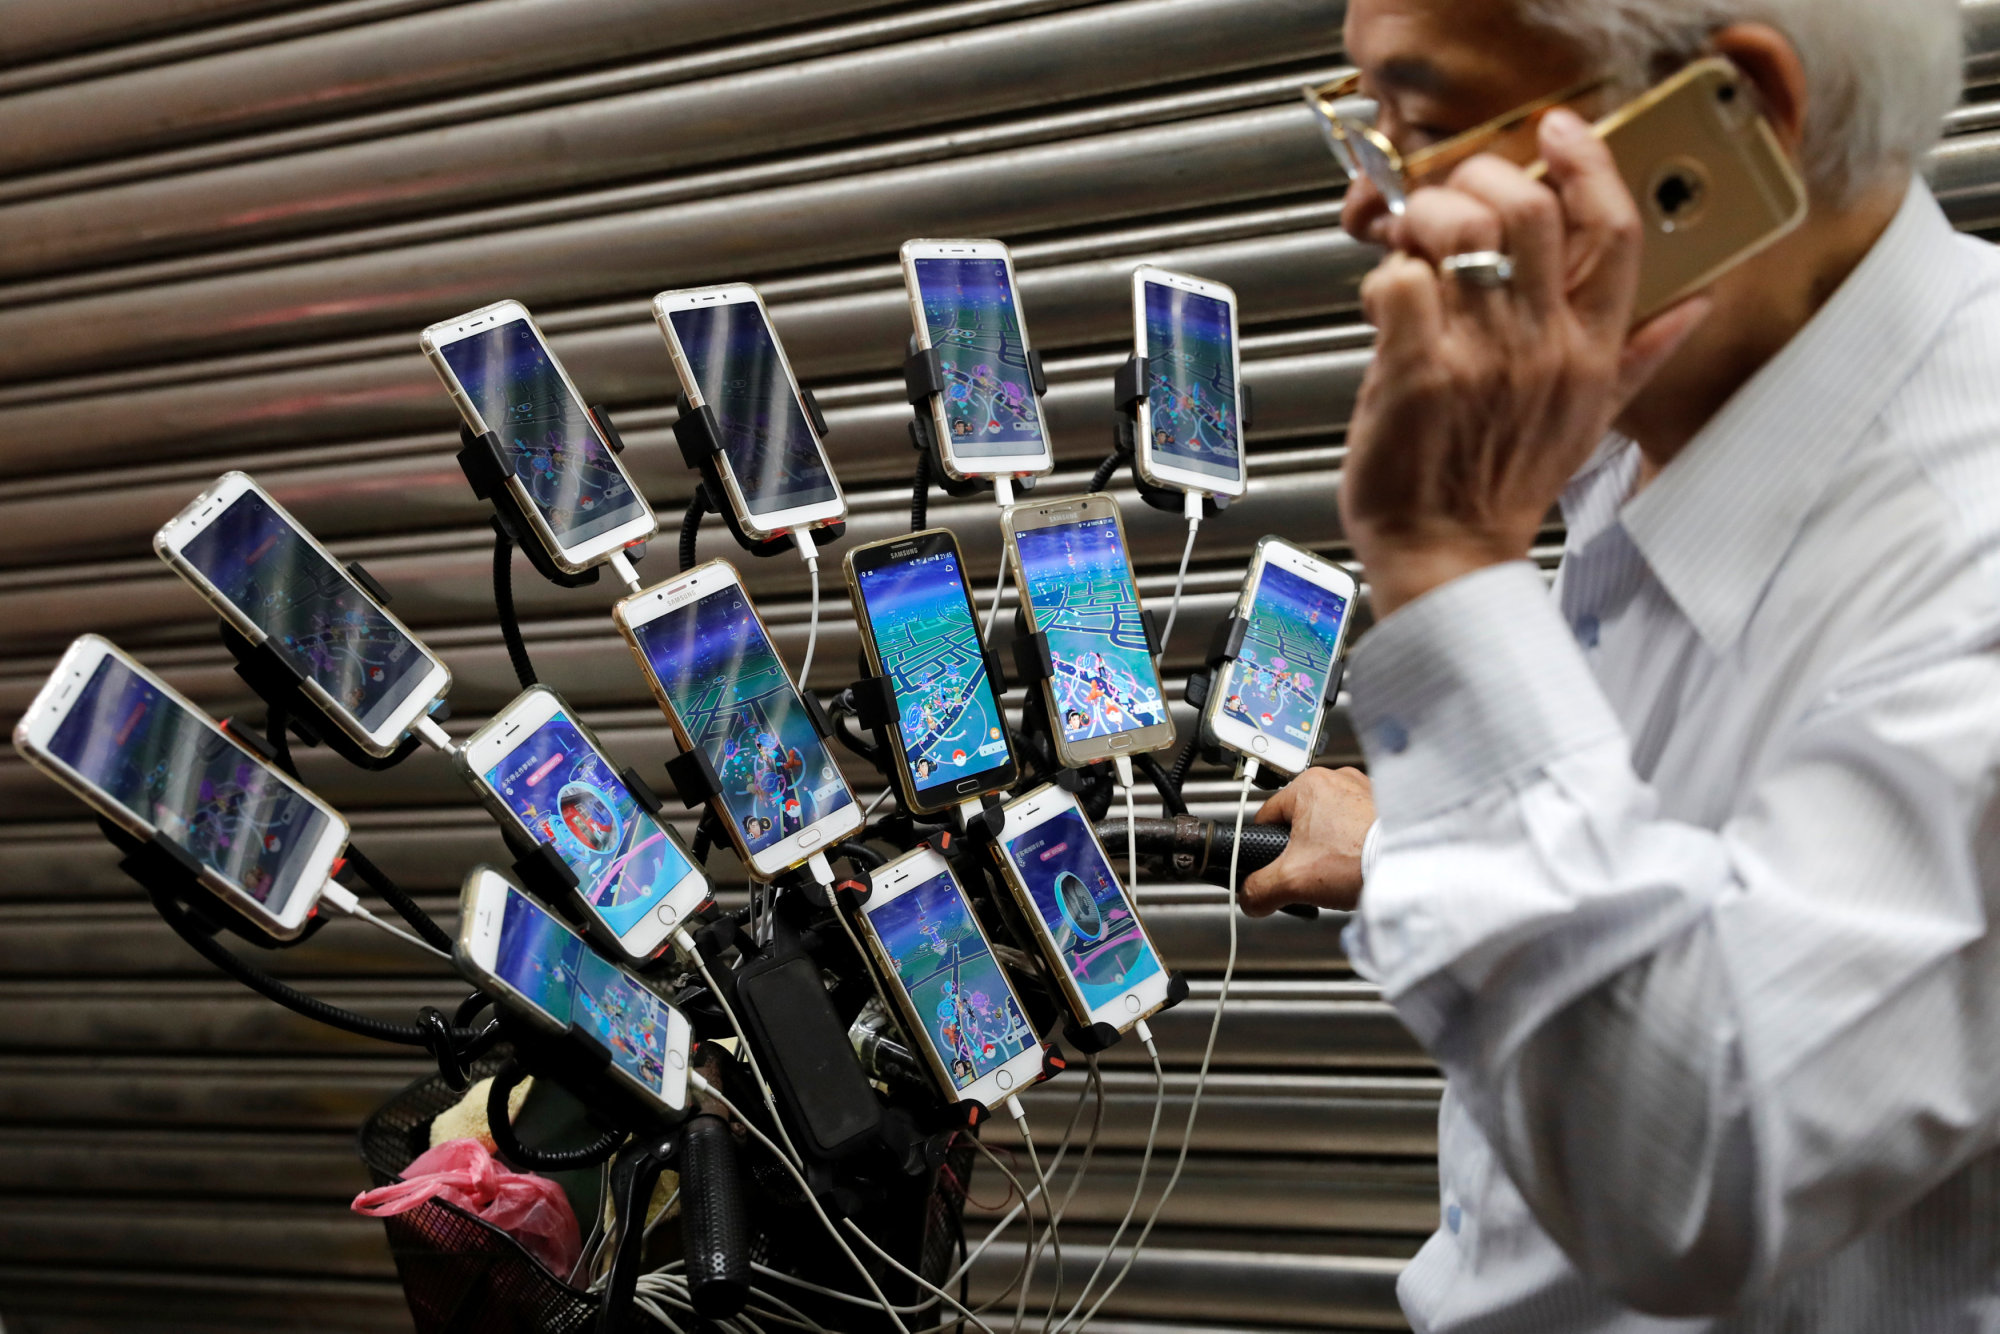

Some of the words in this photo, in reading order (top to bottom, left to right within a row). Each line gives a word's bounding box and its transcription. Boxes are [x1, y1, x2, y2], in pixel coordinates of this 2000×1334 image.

[1048, 512, 1078, 522] SAMSUNG
[890, 547, 918, 559] SAMSUNG
[939, 551, 953, 560] 21:45
[667, 589, 697, 607] SAMSUNG
